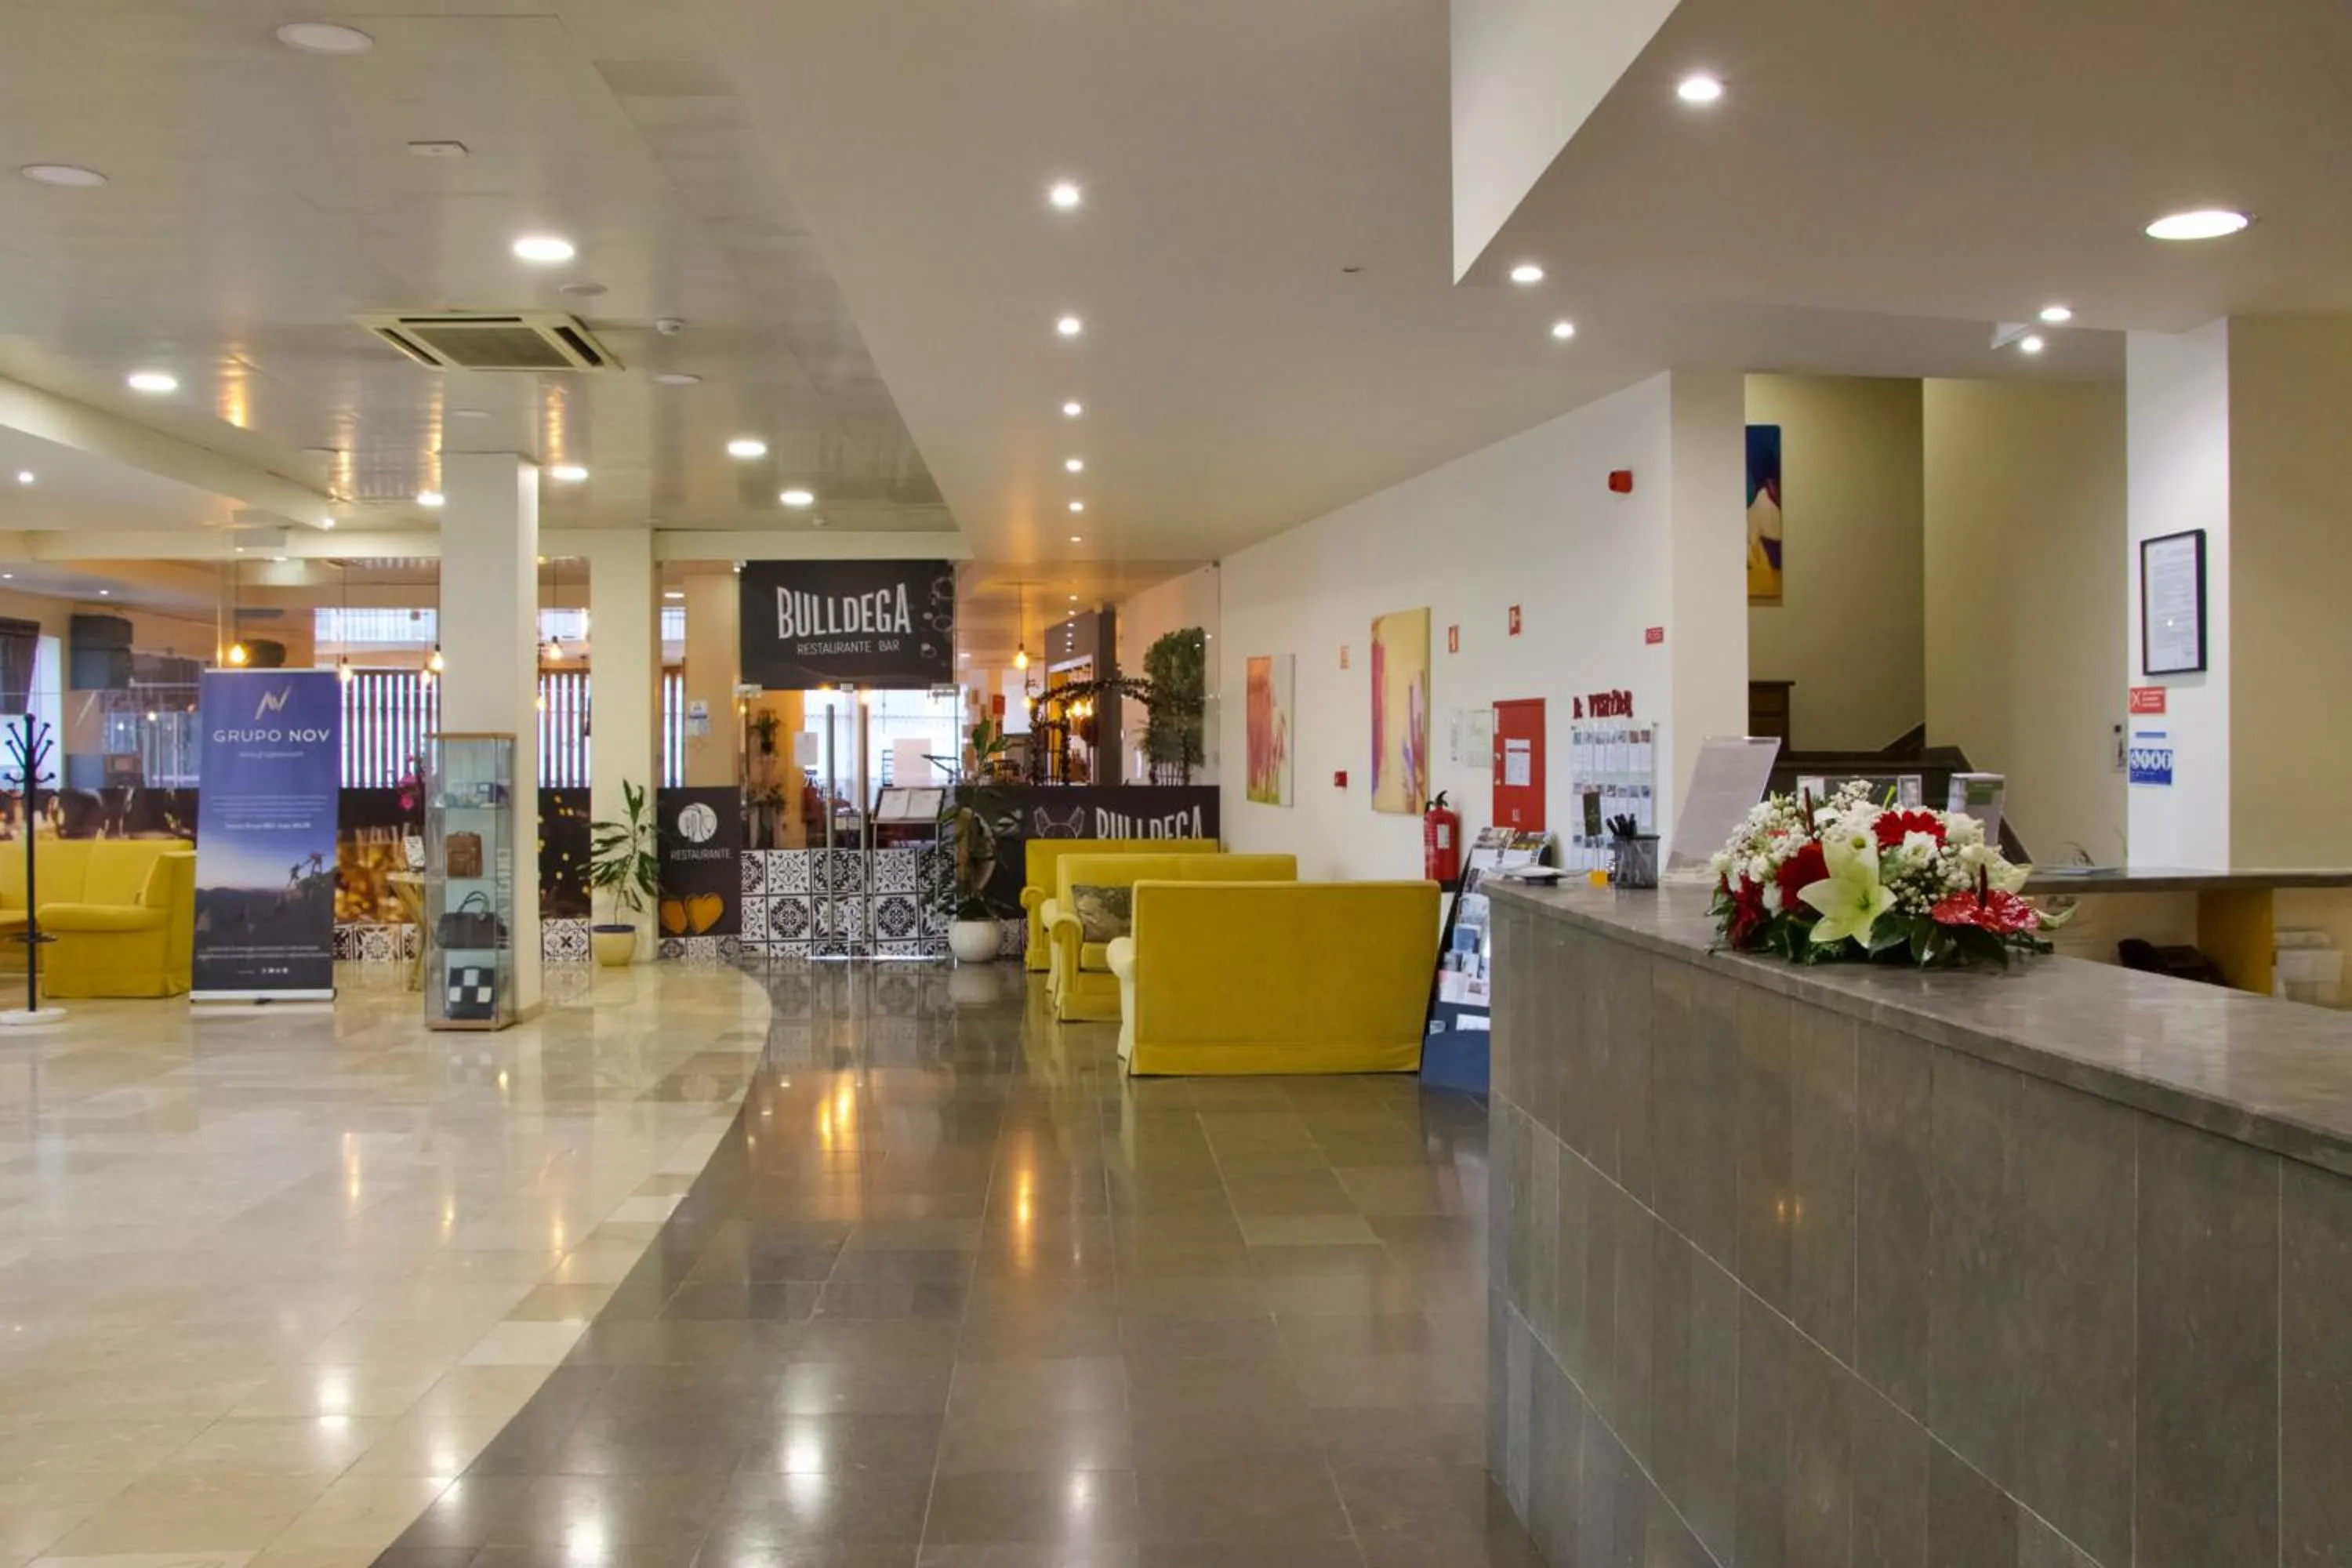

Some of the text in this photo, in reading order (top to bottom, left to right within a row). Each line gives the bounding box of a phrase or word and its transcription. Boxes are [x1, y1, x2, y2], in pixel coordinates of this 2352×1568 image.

[777, 583, 912, 640] BULLDEGA
[797, 639, 900, 655] RESTAURANTE BAR
[212, 728, 330, 742] GRUPO NOV
